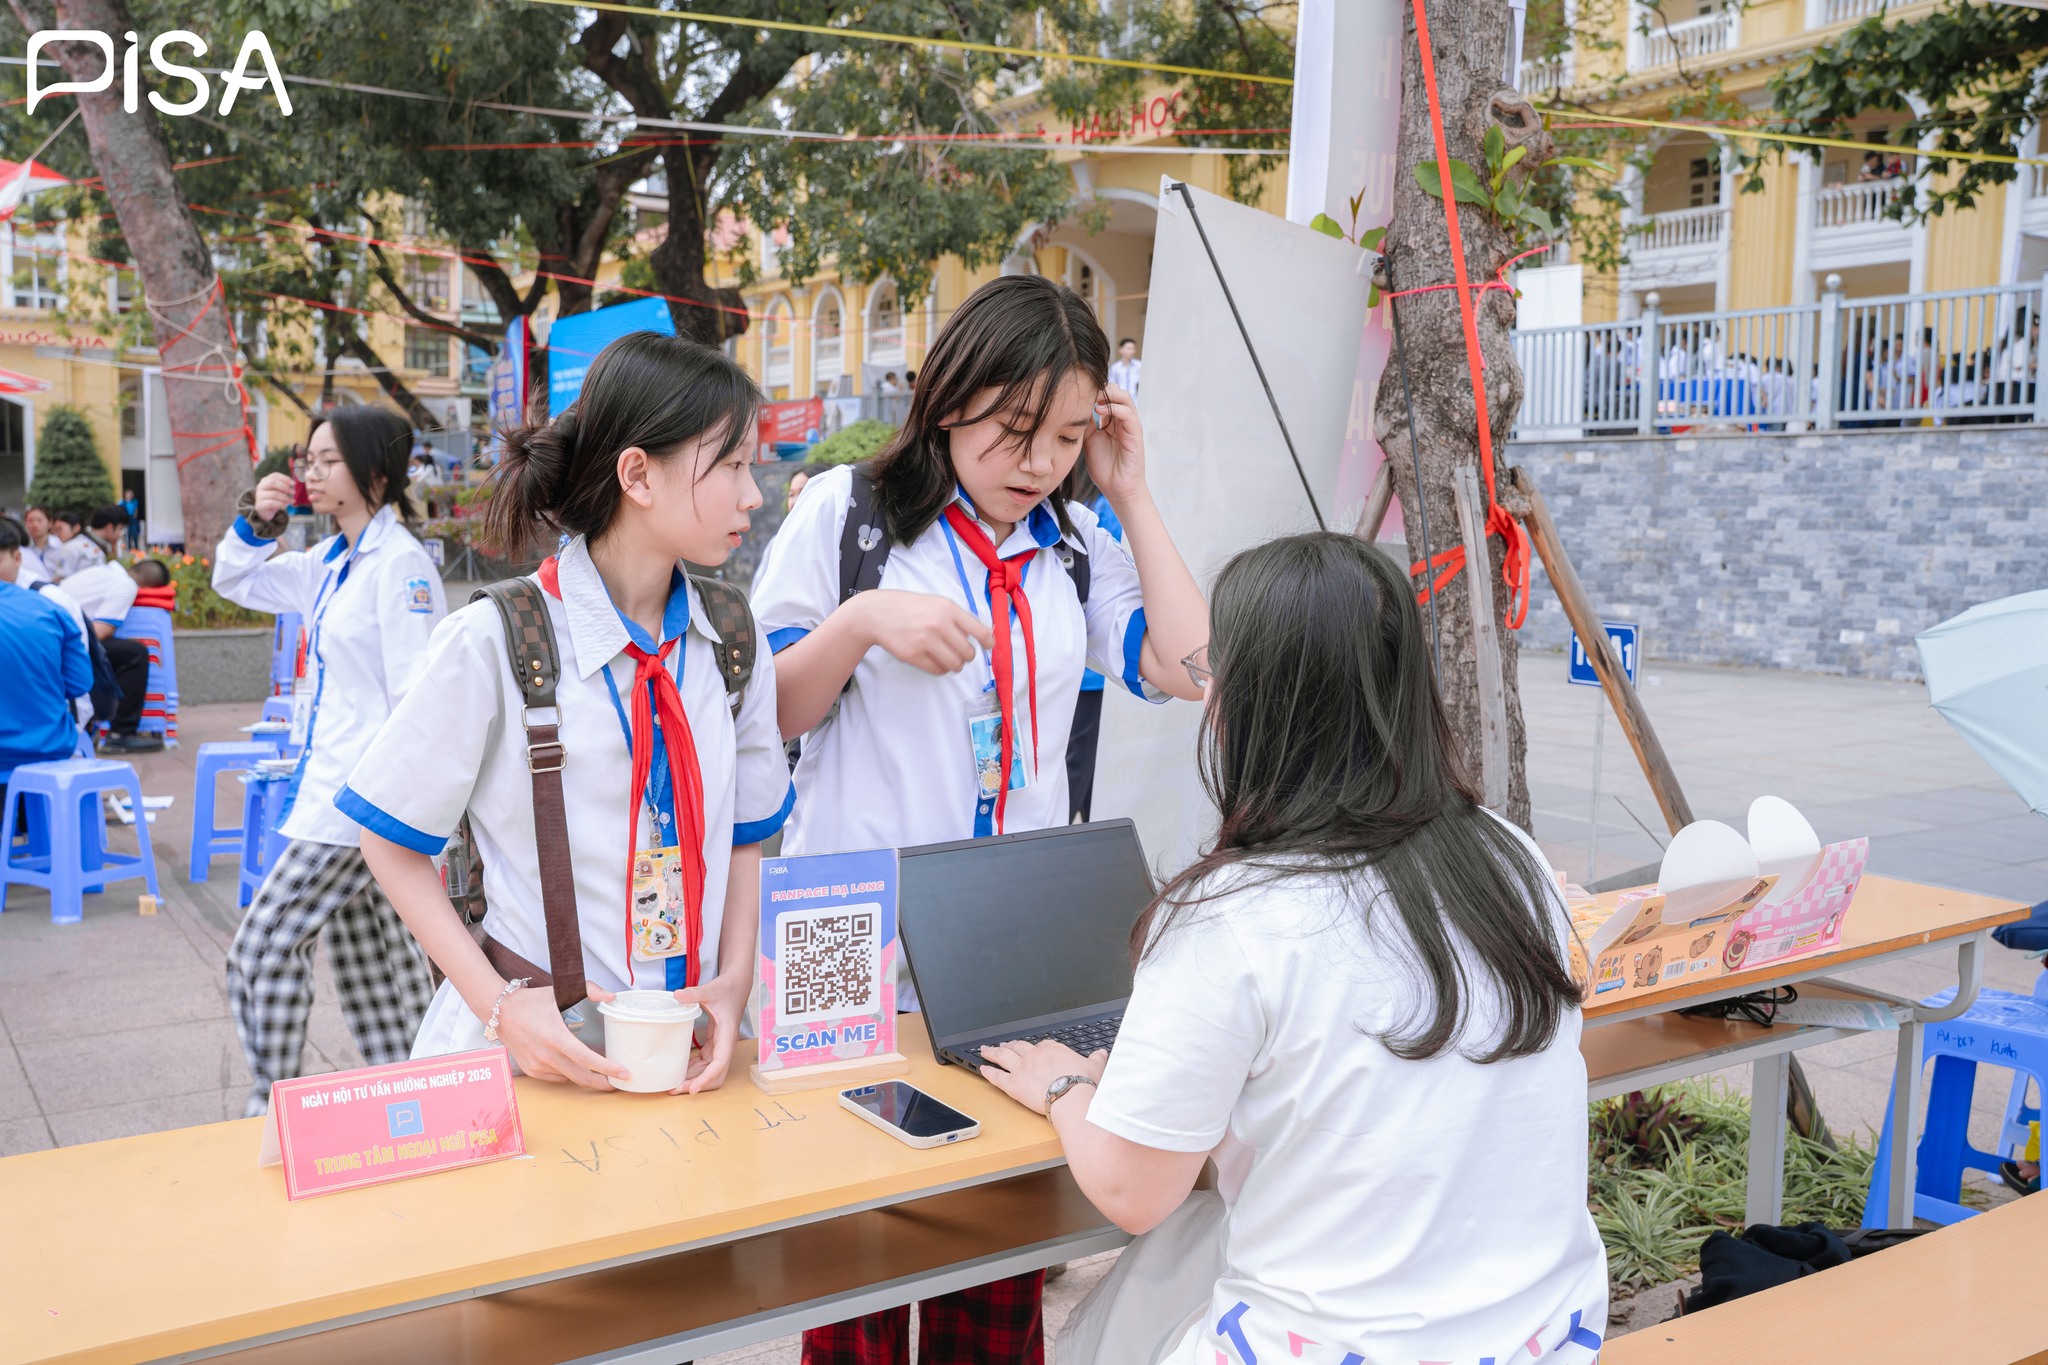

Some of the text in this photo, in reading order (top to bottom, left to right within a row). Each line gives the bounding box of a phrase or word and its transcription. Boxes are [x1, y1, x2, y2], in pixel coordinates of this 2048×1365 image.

[772, 881, 885, 902] FANPAGE HẠ LONG
[1600, 953, 1626, 968] CAPY
[775, 1022, 877, 1054] SCAN ME
[301, 1067, 492, 1110] NGÀY HỘI TƯ VẤN HƯỚNG NGHIỆP 2026
[314, 1128, 499, 1176] TRUNG TÂM NGOẠI NGỮ PISA
